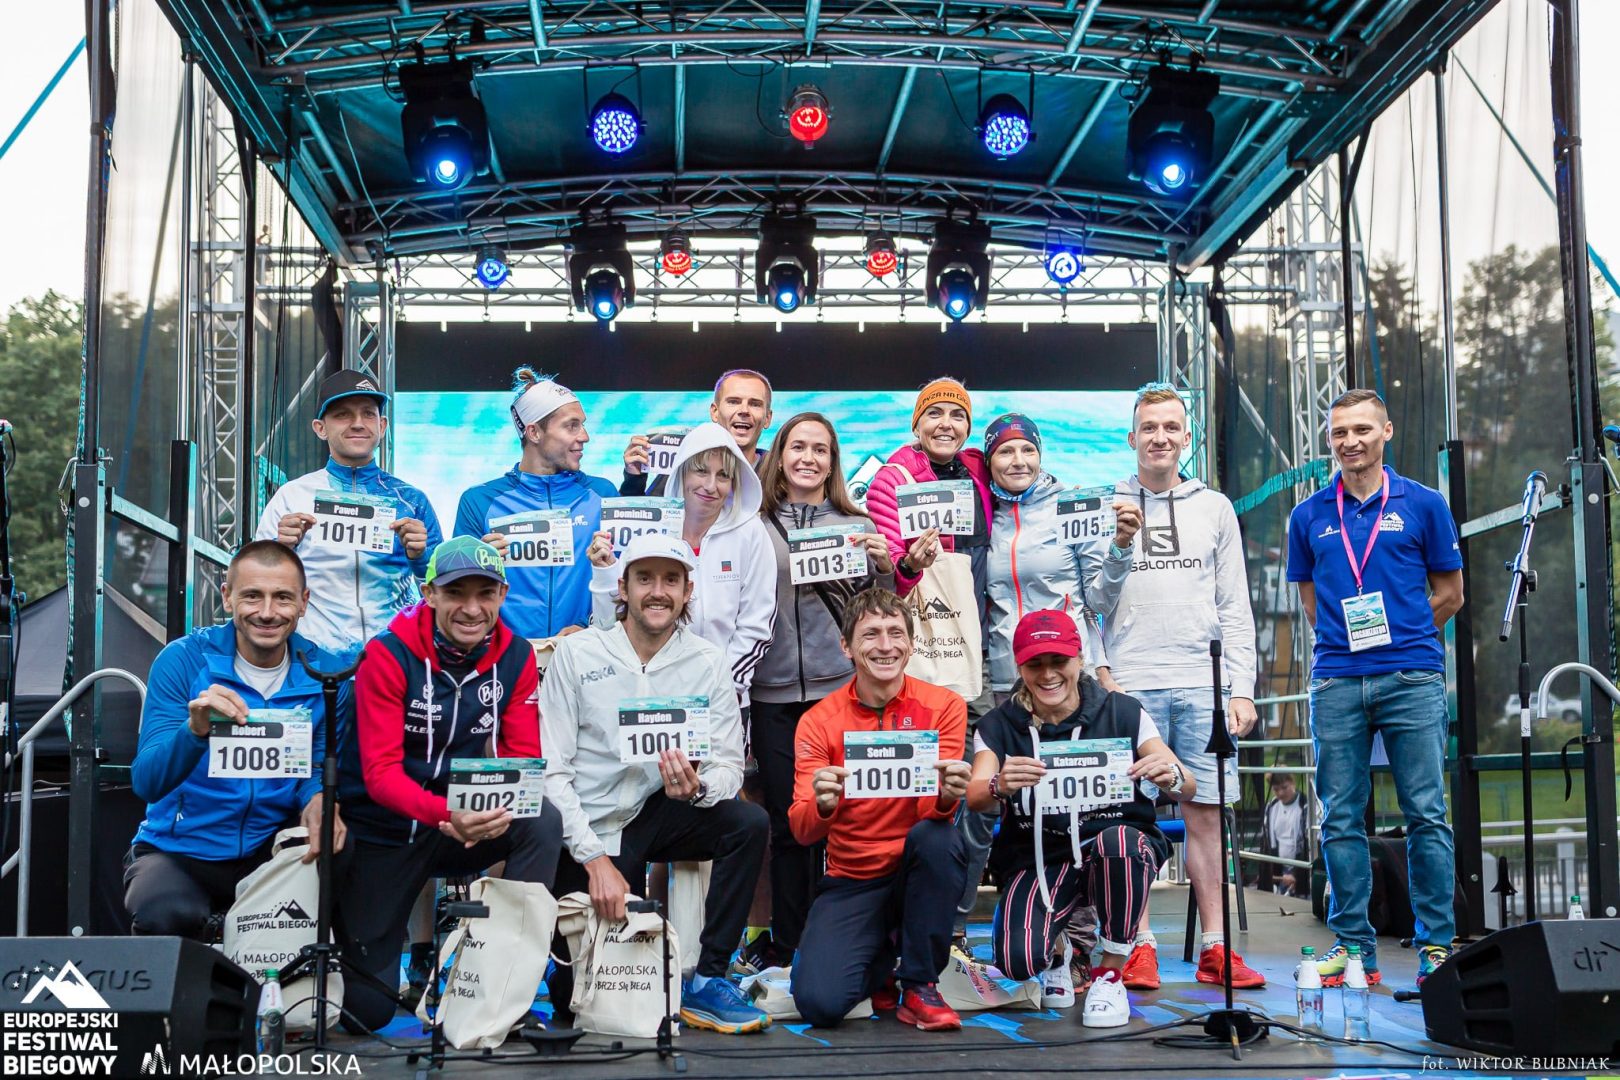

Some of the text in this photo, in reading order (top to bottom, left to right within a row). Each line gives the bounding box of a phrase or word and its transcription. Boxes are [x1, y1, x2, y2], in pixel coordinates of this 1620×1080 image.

[662, 436, 680, 445] Piotr
[917, 494, 938, 504] Edyta
[1074, 502, 1087, 511] Ewa
[613, 510, 653, 519] Dominika
[905, 509, 954, 532] 1014
[319, 521, 367, 545] 1011
[509, 523, 534, 533] Kamil
[1061, 517, 1100, 540] 1015
[503, 540, 549, 561] 006
[800, 538, 838, 551] Alexandra
[796, 553, 844, 578] 1013
[927, 610, 962, 620] BIEGOWY
[580, 665, 617, 686] HOKA
[410, 699, 442, 713] Enega
[638, 712, 672, 724] Hayden
[231, 725, 267, 737] Robert
[627, 732, 681, 755] 1001
[217, 746, 280, 771] 1008
[867, 747, 896, 759] Serhii
[1053, 757, 1099, 768] Katarzyna
[471, 773, 505, 784] Marcin
[852, 767, 911, 791] 1010
[1048, 775, 1106, 799] 1016
[456, 791, 515, 812] 1002
[236, 912, 273, 923] EUROPEJSKI
[237, 920, 319, 934] FESTIWAL BIEGOW
[630, 981, 652, 991] BIEGA
